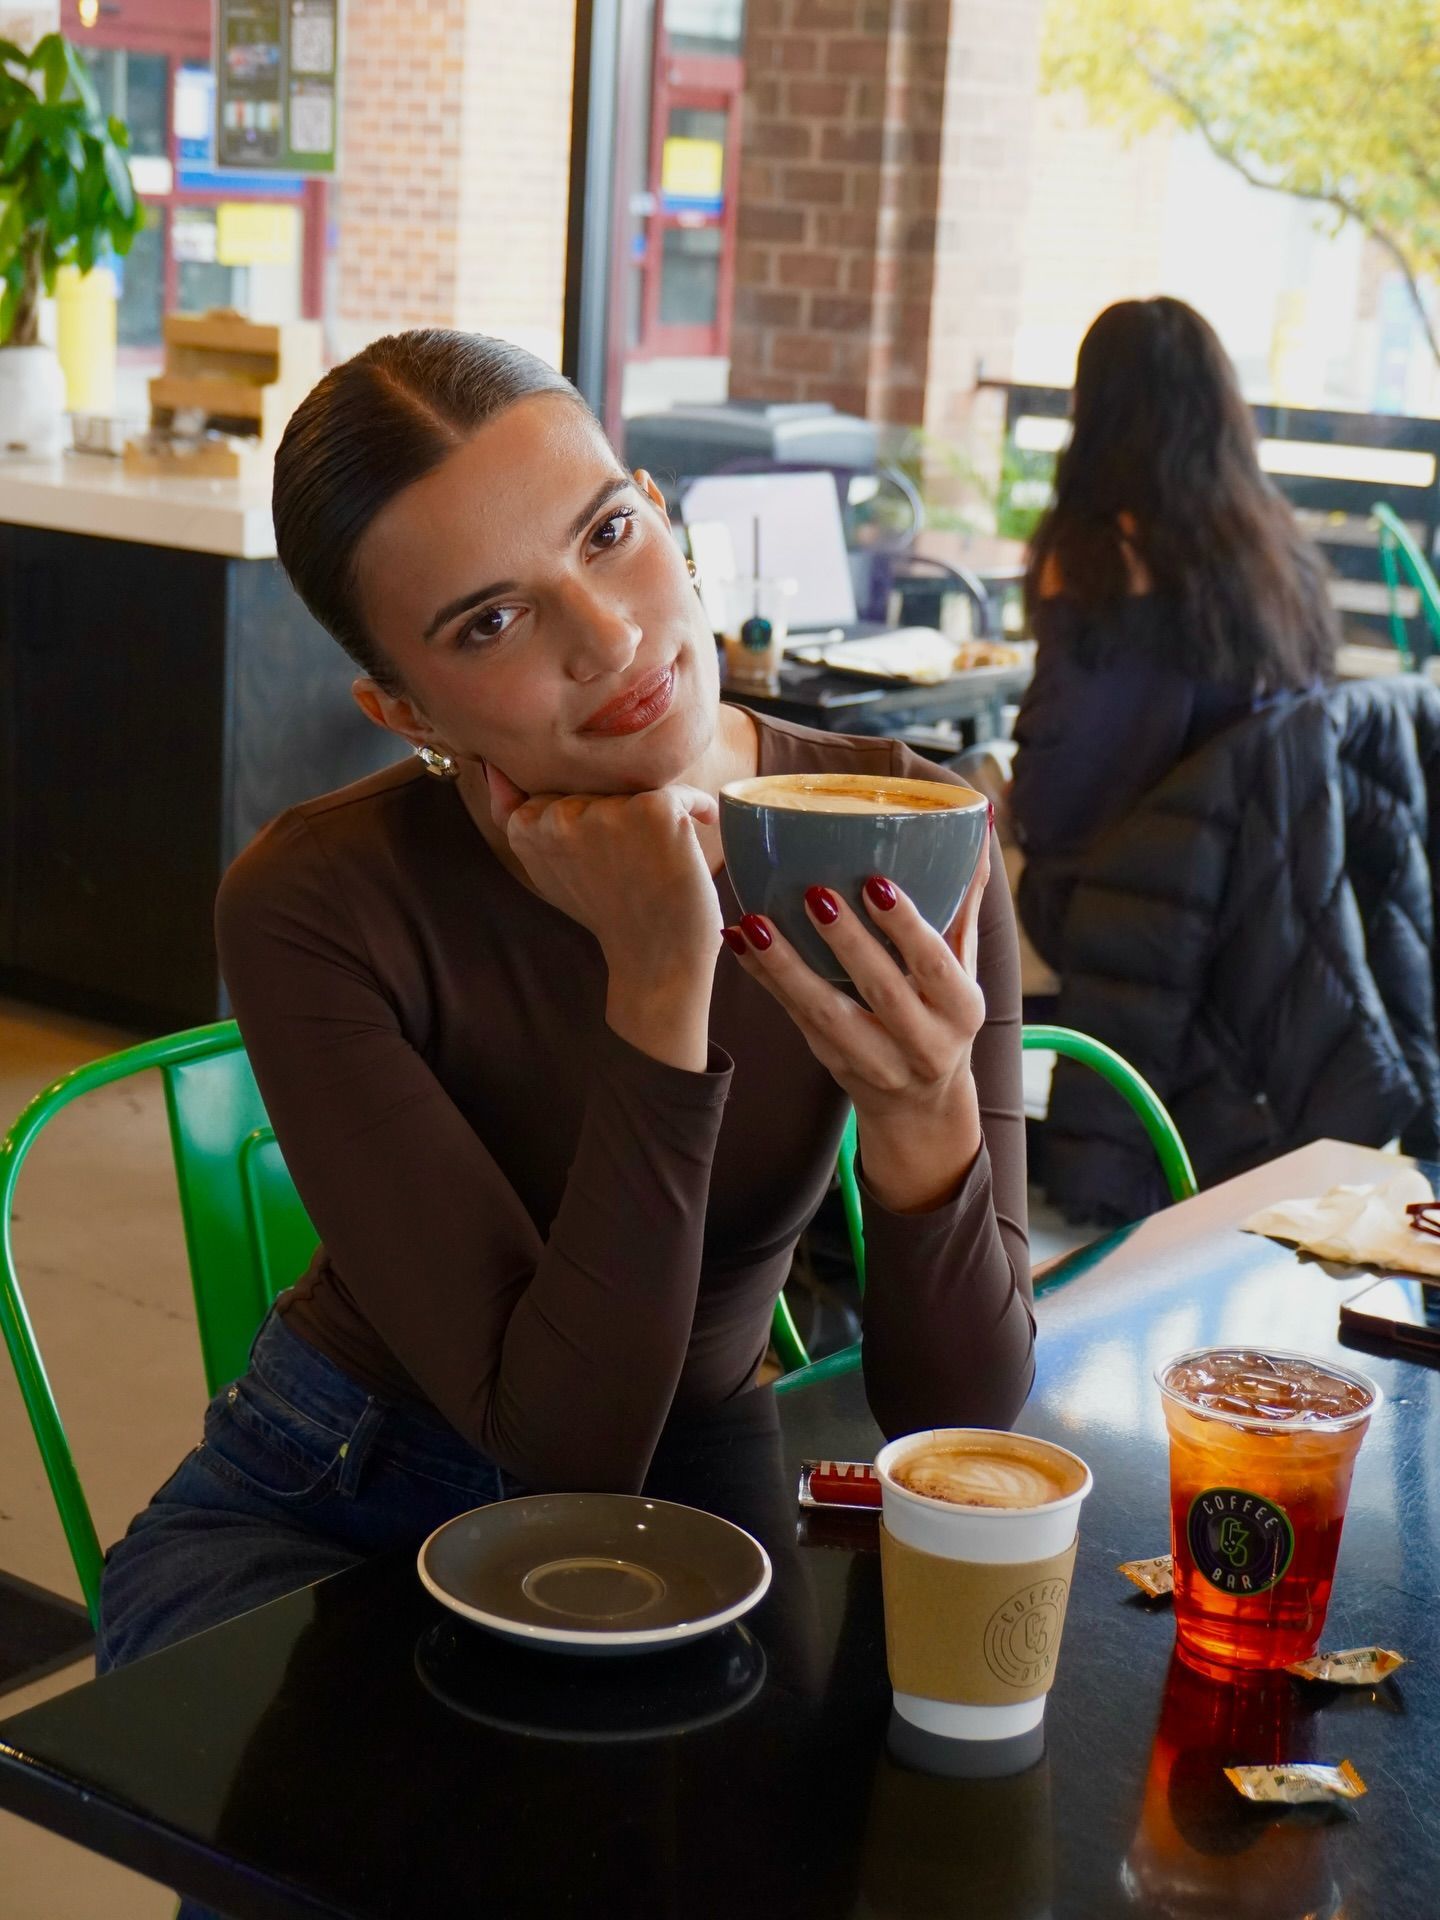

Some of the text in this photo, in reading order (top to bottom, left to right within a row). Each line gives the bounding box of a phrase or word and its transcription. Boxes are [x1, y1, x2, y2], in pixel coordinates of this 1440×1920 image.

[1203, 1495, 1279, 1529] COFFEE
[1212, 1567, 1253, 1590] BAR
[1001, 1585, 1064, 1623] COFFEE
[1021, 1655, 1050, 1681] BAR
